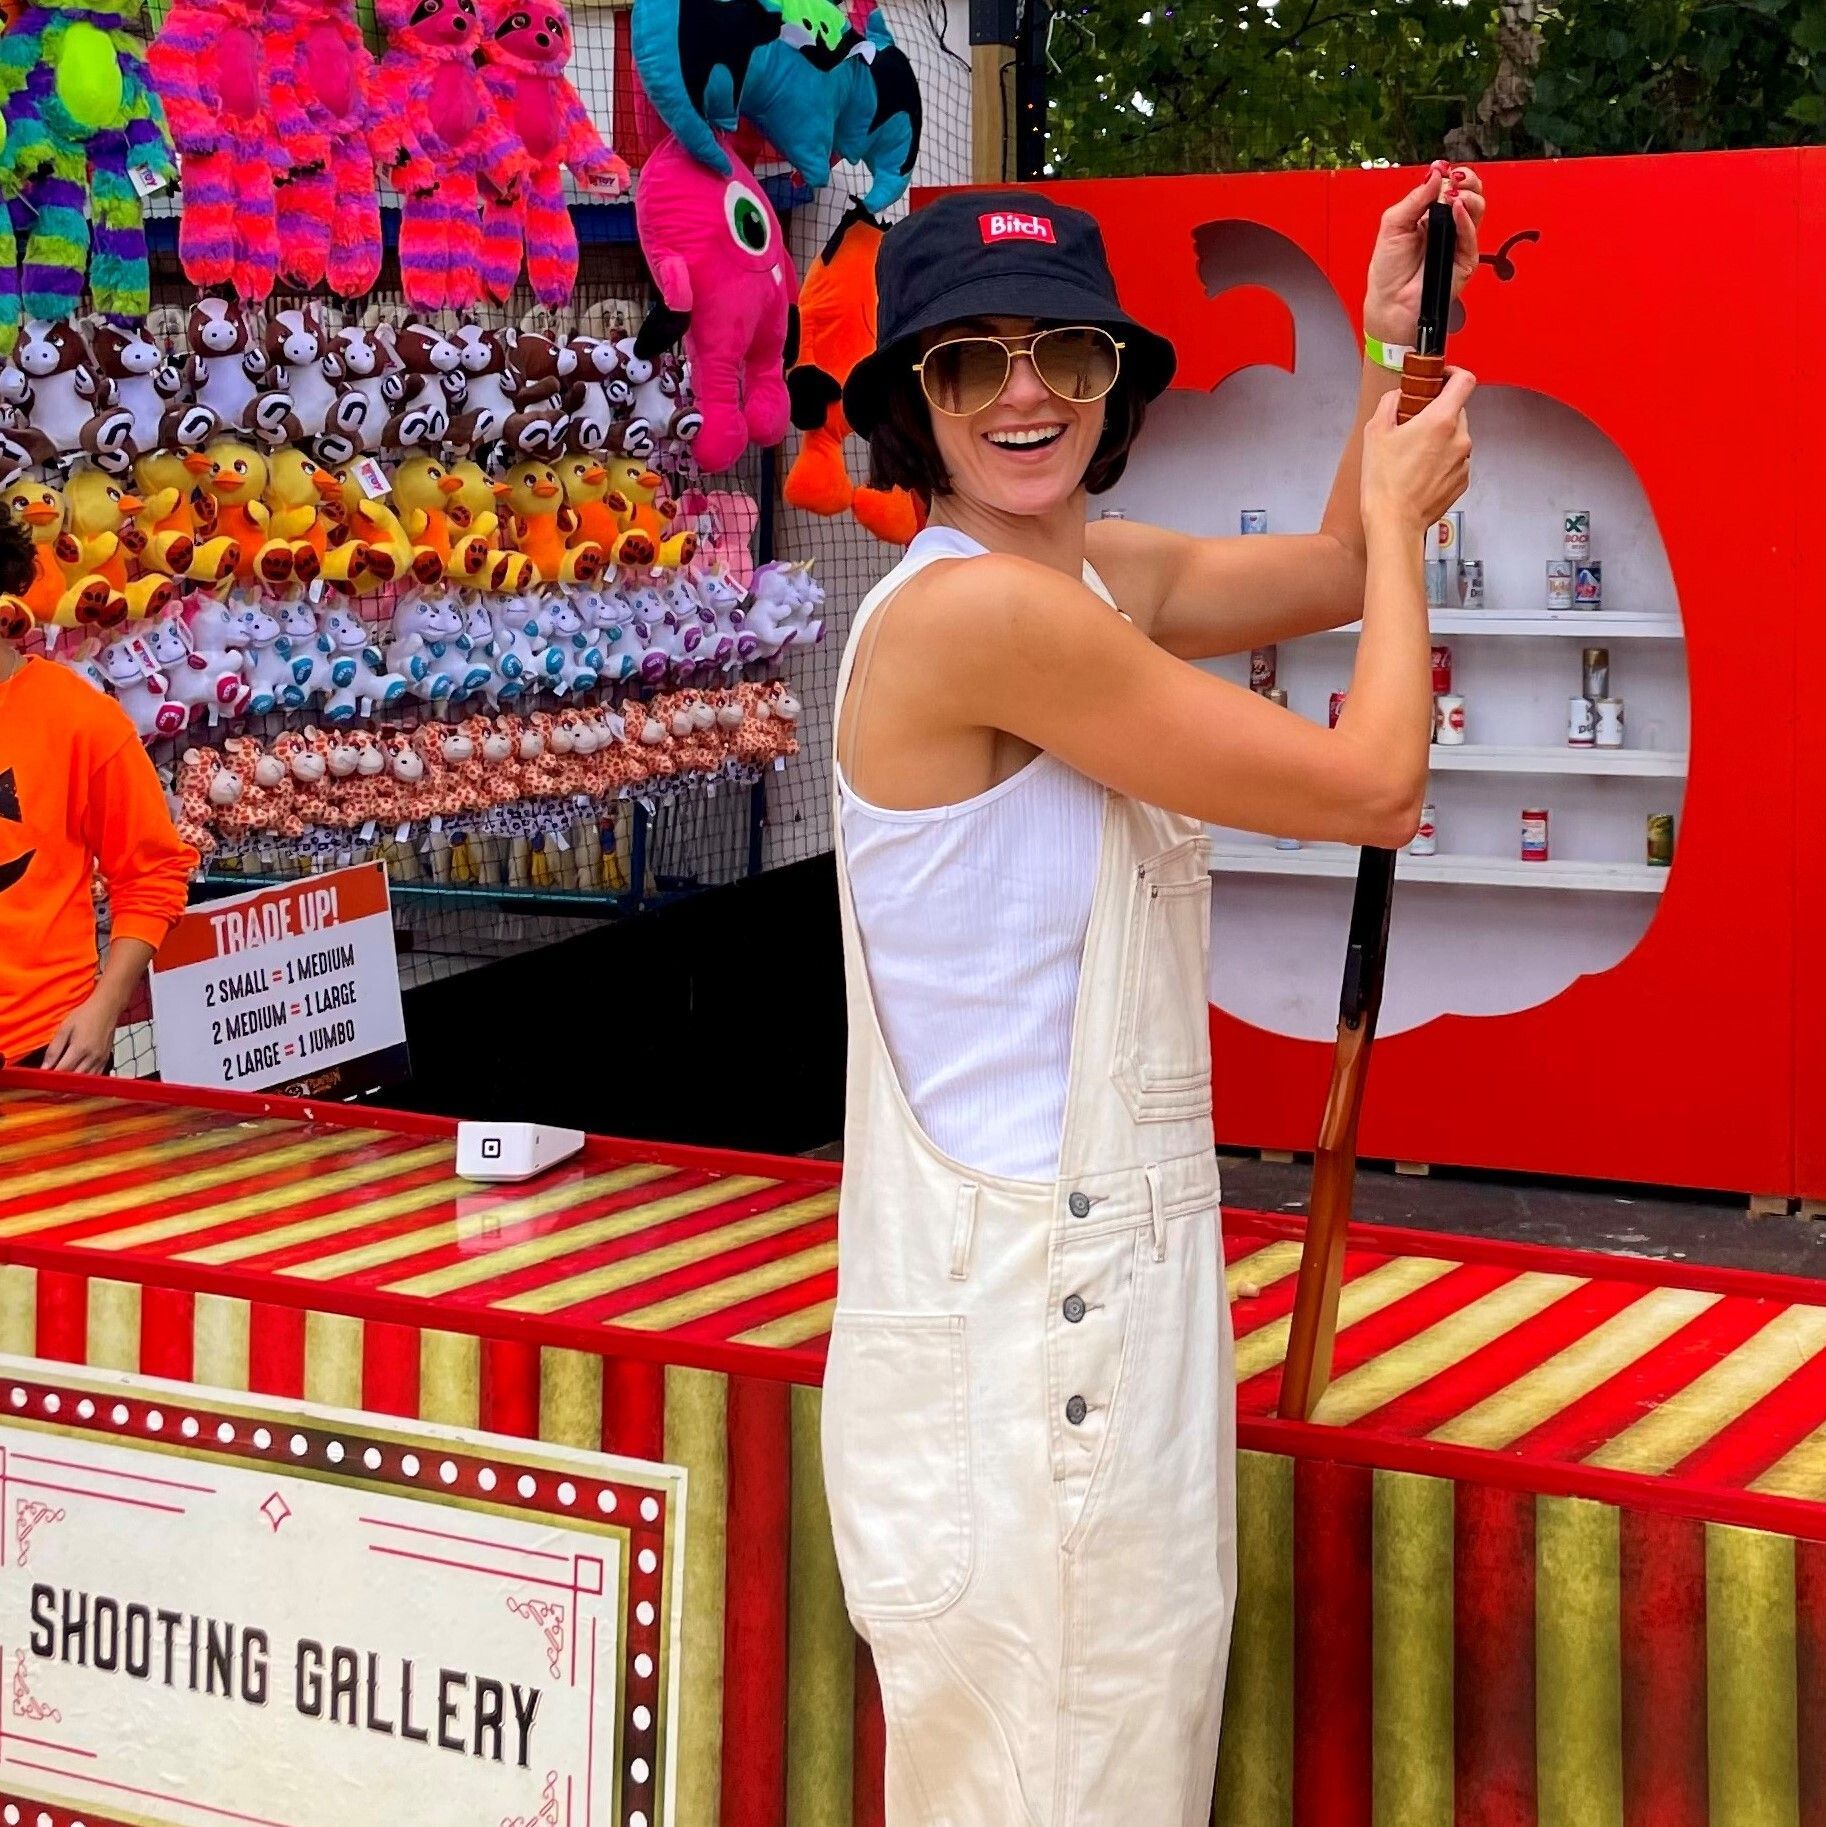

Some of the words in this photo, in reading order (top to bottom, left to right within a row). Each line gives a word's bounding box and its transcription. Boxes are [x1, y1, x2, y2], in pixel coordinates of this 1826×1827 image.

[990, 214, 1047, 238] Bitch
[210, 898, 295, 957] TRADE
[299, 886, 340, 935] UP!
[205, 983, 216, 1008] 2
[219, 968, 269, 1003] SMALL
[286, 960, 295, 985] 1
[297, 943, 355, 981] MEDIUM
[212, 1020, 223, 1045] 2
[225, 1001, 287, 1041] MEDIUM
[304, 993, 313, 1017] 1
[315, 980, 357, 1014] LARGE
[222, 1057, 234, 1082] 2
[236, 1042, 282, 1078] LARGE
[298, 1034, 307, 1058] 1
[309, 1019, 355, 1055] JUMBO
[29, 1582, 270, 1706] SHOOTING
[295, 1637, 543, 1768] GALLERY
